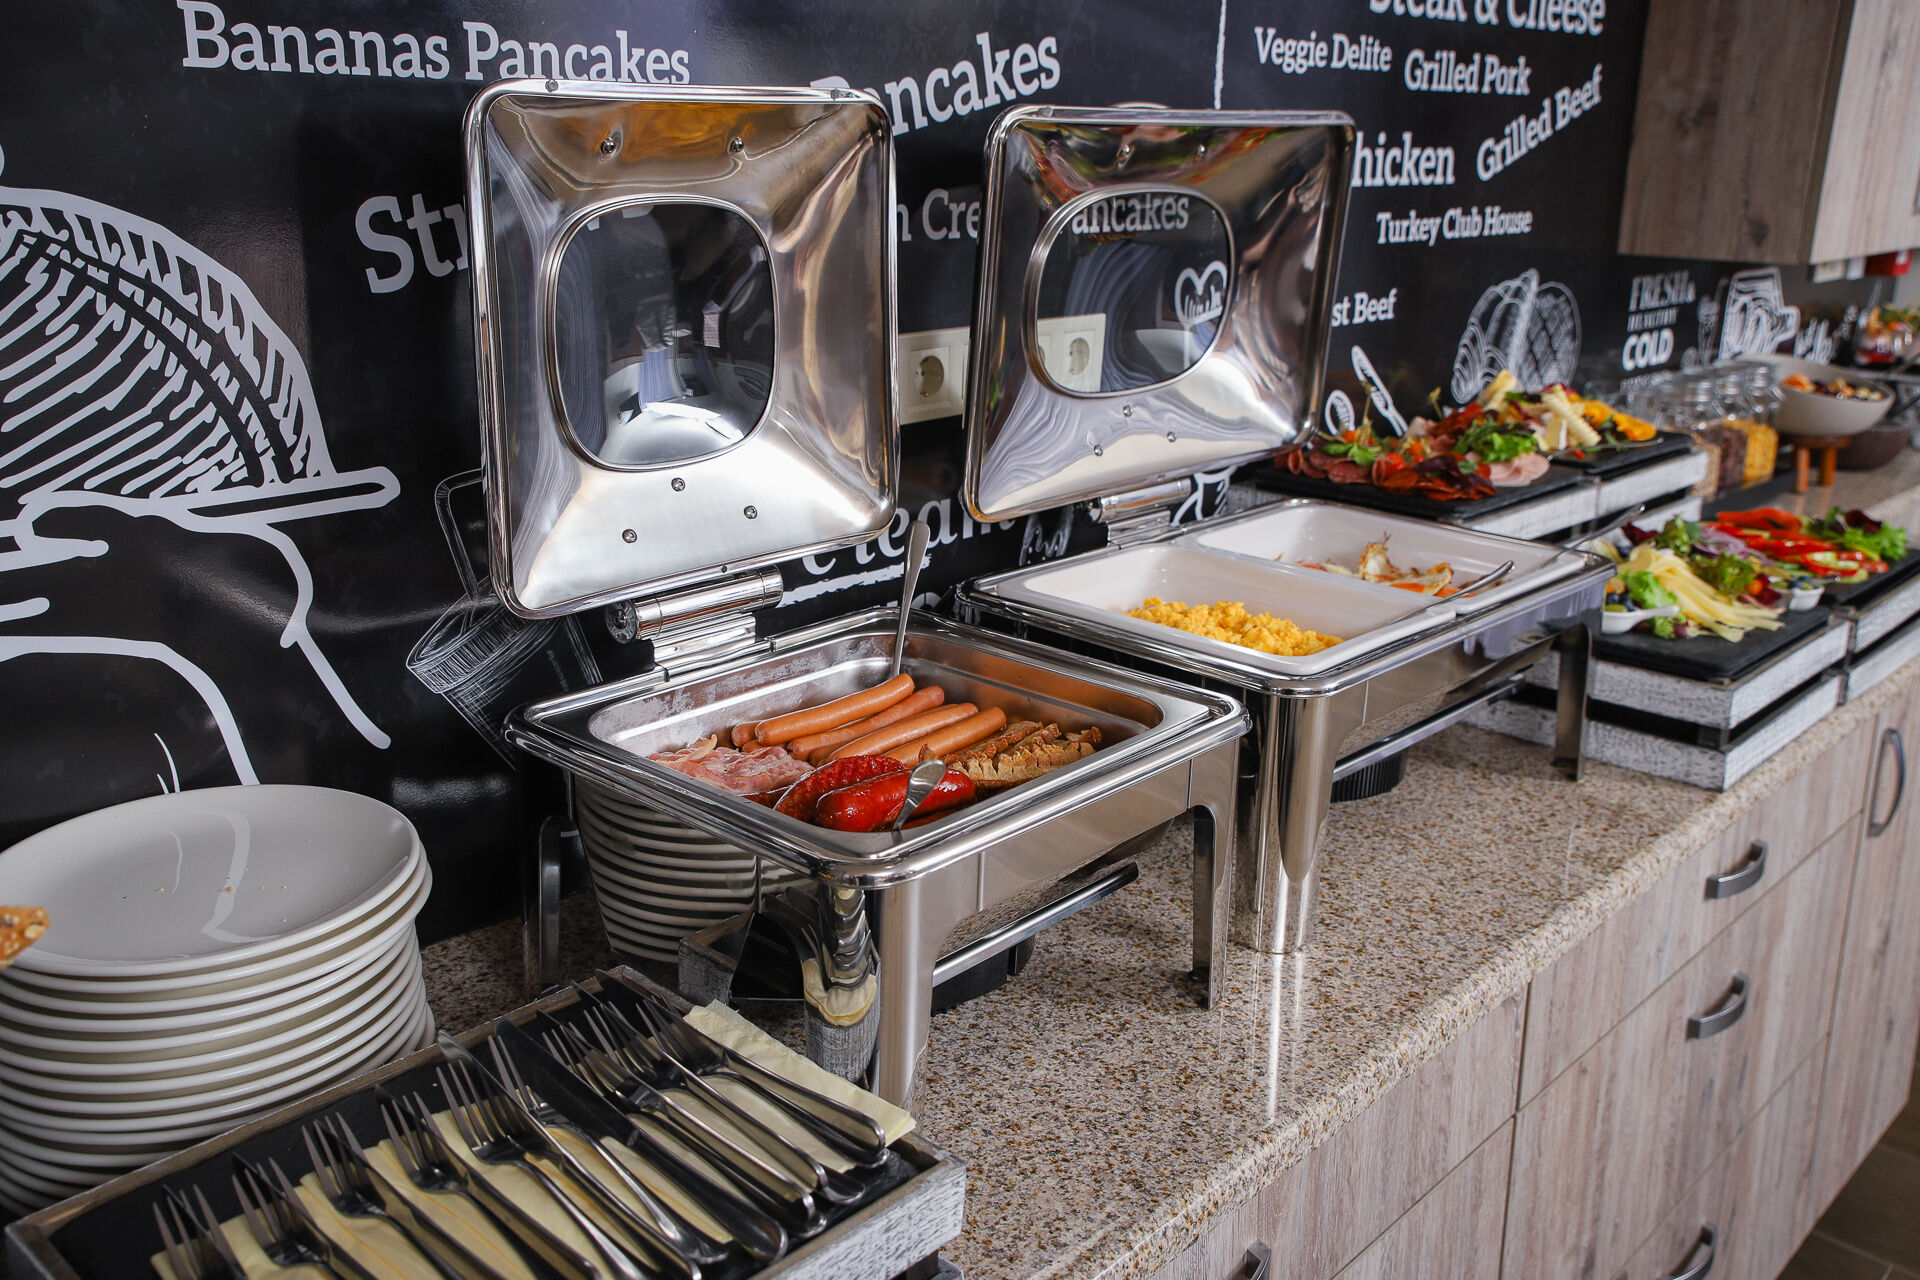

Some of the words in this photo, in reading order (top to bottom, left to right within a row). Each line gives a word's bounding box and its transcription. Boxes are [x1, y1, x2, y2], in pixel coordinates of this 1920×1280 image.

[177, 0, 450, 80] Bananas
[463, 20, 690, 85] Pancakes
[1254, 26, 1328, 74] Veggie
[1330, 33, 1393, 72] Delite
[810, 31, 1061, 137] ncakes
[1404, 49, 1481, 93] Grilled
[1481, 54, 1532, 96] Pork
[1476, 97, 1553, 182] Grilled
[1554, 63, 1603, 131] Beef
[1376, 209, 1441, 247] Turkey
[1442, 206, 1482, 240] Club
[1482, 205, 1533, 236] House
[1352, 287, 1398, 325] Beef
[1622, 328, 1675, 371] COLD
